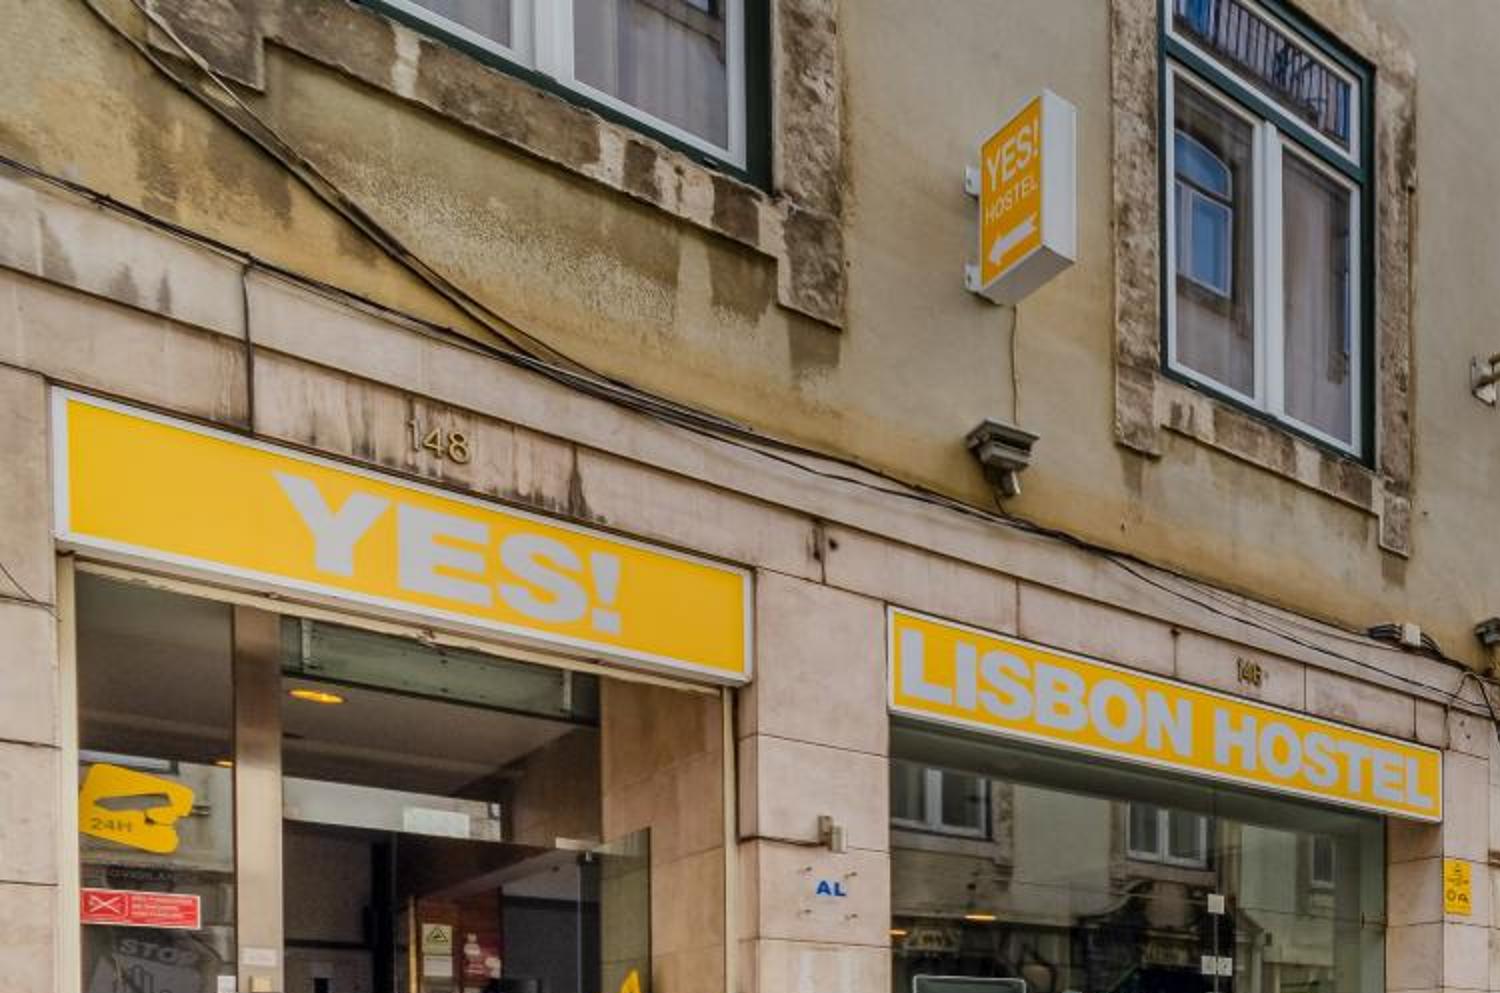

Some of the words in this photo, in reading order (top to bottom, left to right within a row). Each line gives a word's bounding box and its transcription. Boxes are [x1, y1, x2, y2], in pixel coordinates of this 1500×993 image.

[986, 117, 1037, 193] YES!
[985, 175, 1038, 225] HOSTEL
[407, 421, 470, 464] 148
[273, 469, 622, 635] YES!
[900, 628, 1194, 757] LISBON
[1213, 707, 1432, 808] HOSTEL
[815, 879, 846, 897] AL
